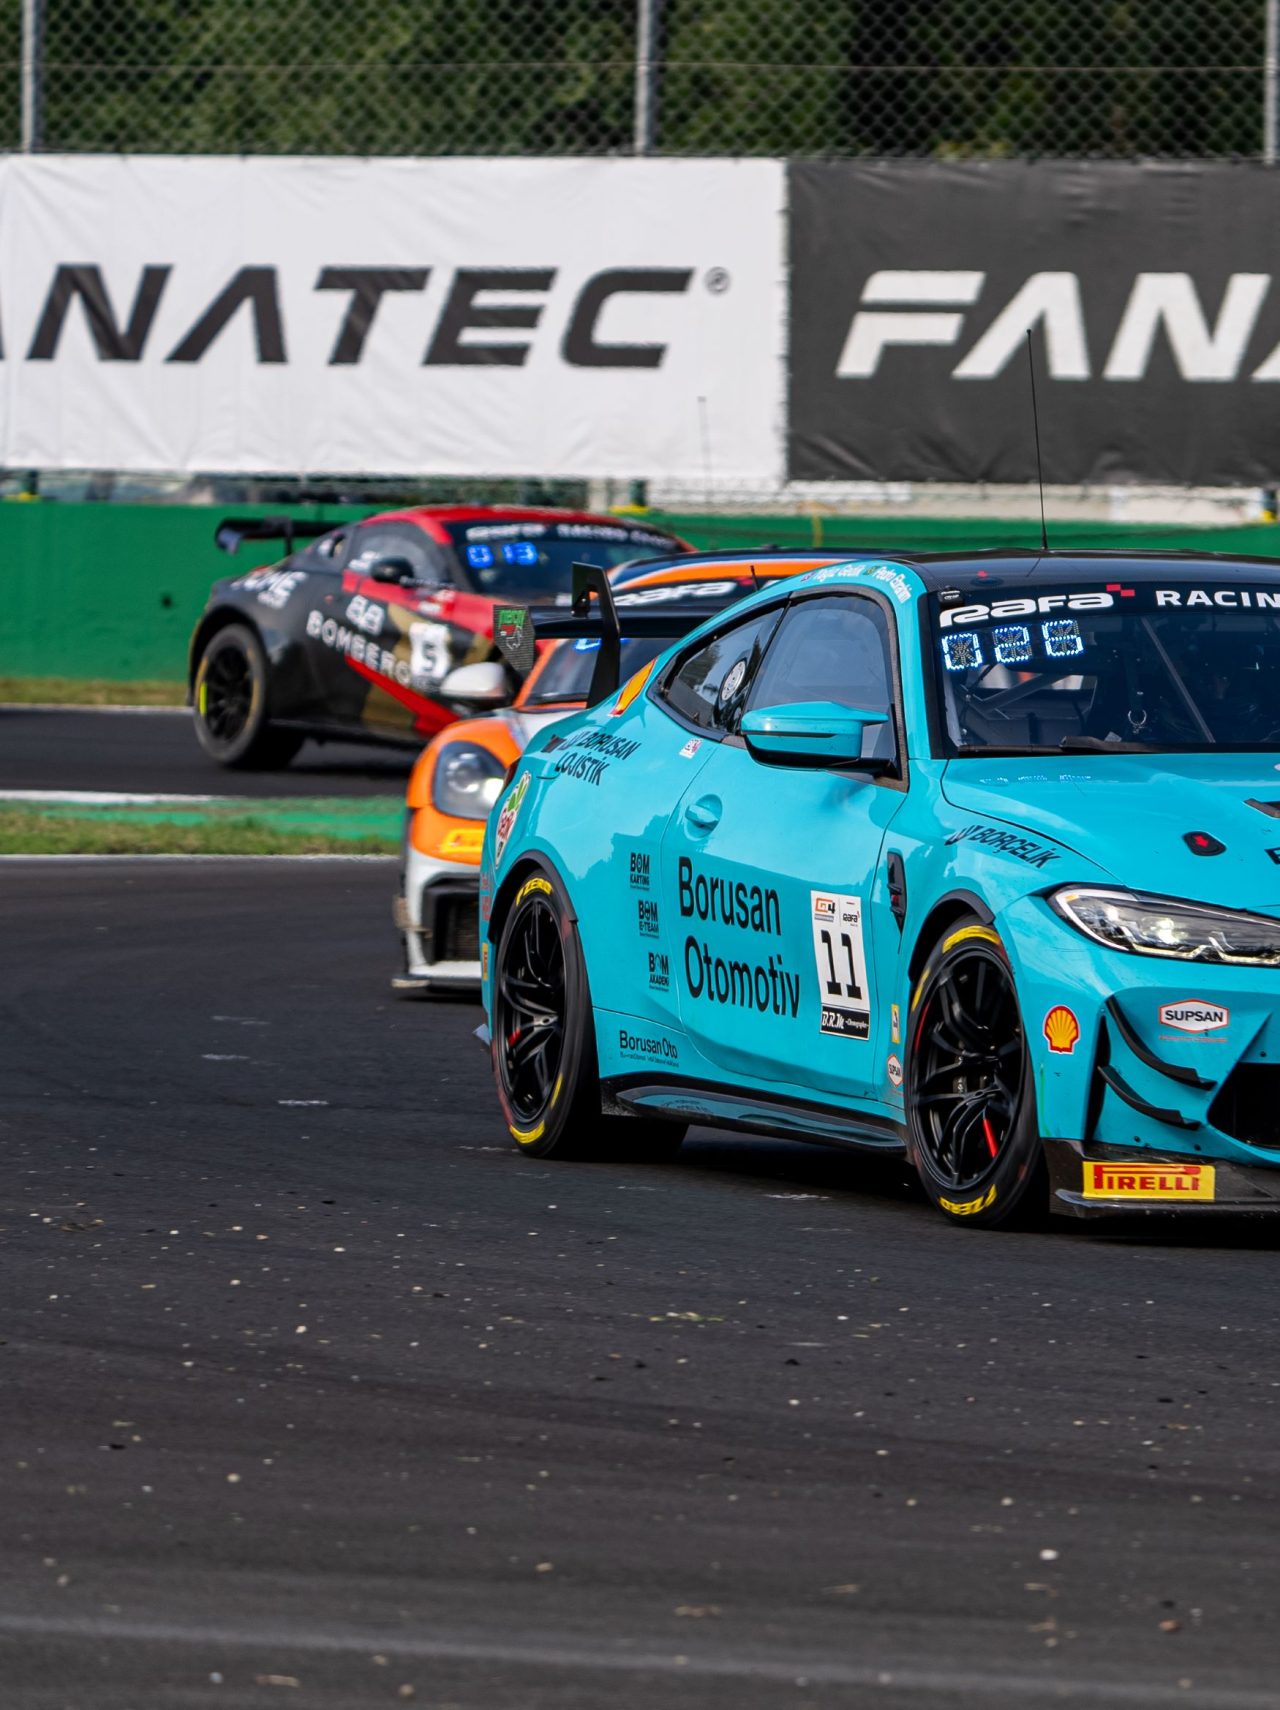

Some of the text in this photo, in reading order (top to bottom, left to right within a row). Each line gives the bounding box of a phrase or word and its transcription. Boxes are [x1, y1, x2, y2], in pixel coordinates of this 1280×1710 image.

[0, 262, 695, 369] NATEC
[578, 731, 642, 761] BORUSAN
[678, 855, 782, 936] Borusan
[684, 935, 800, 1019] Otomotiv
[820, 929, 862, 1000] 11
[1164, 1009, 1224, 1022] SUPSAN
[619, 1030, 662, 1055] Borusan
[1093, 1164, 1201, 1191] PIRELLI
